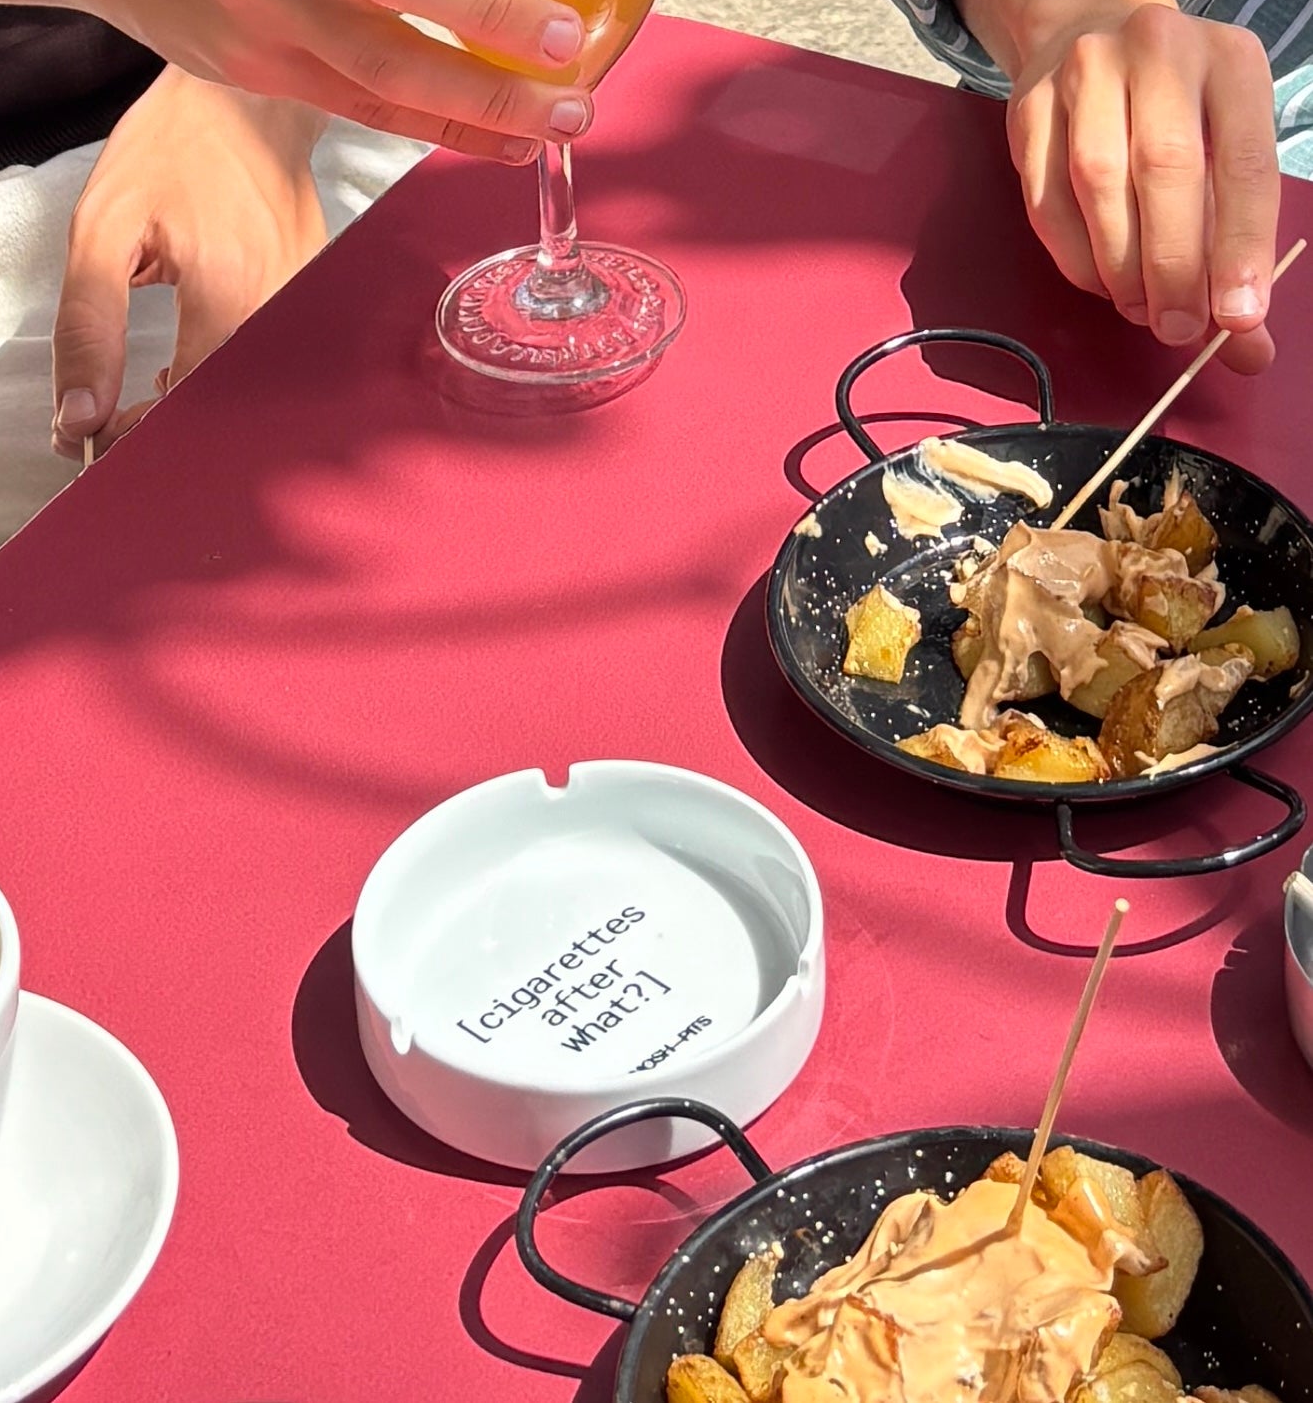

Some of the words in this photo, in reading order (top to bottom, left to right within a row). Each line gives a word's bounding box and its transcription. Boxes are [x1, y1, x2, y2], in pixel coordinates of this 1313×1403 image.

[456, 906, 646, 1044] [cigarettes
[541, 959, 624, 1027] after
[560, 970, 672, 1053] what?]
